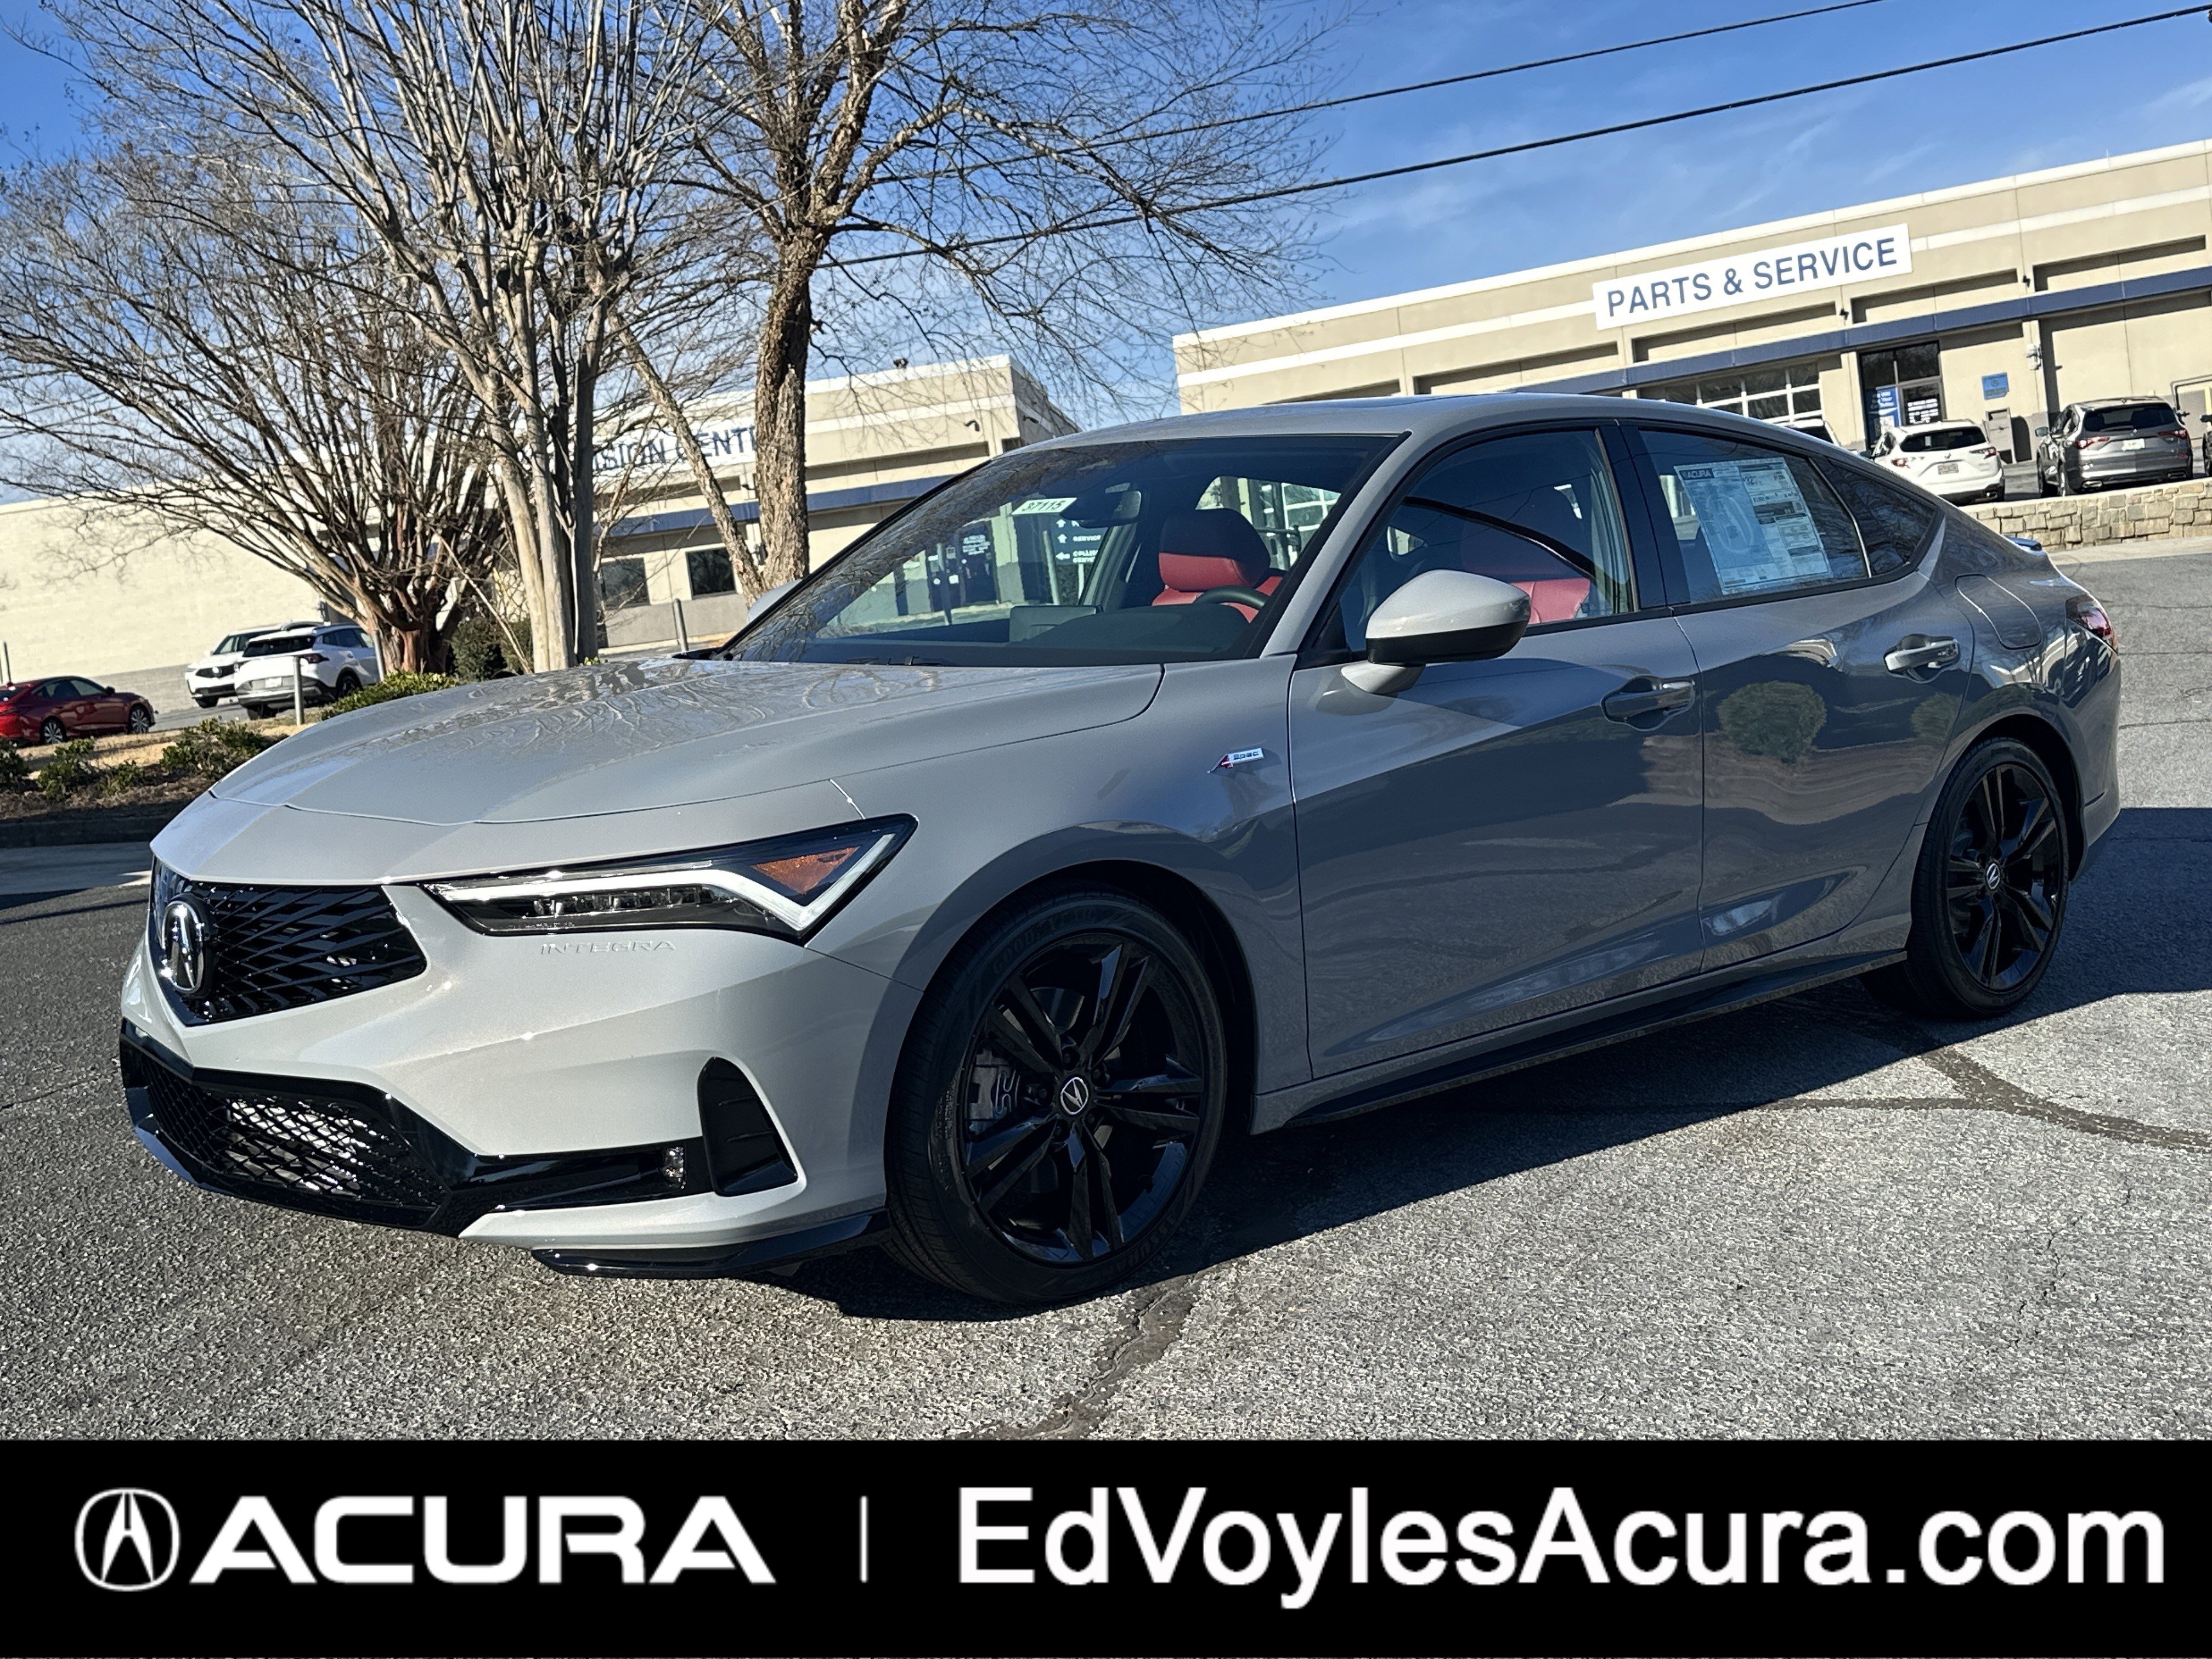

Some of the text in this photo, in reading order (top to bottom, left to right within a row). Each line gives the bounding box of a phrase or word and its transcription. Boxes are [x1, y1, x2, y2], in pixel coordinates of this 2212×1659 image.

[1607, 237, 1897, 317] PARTS & SERVICE
[1688, 470, 1712, 478] ACURA
[540, 940, 677, 955] INTEGRA
